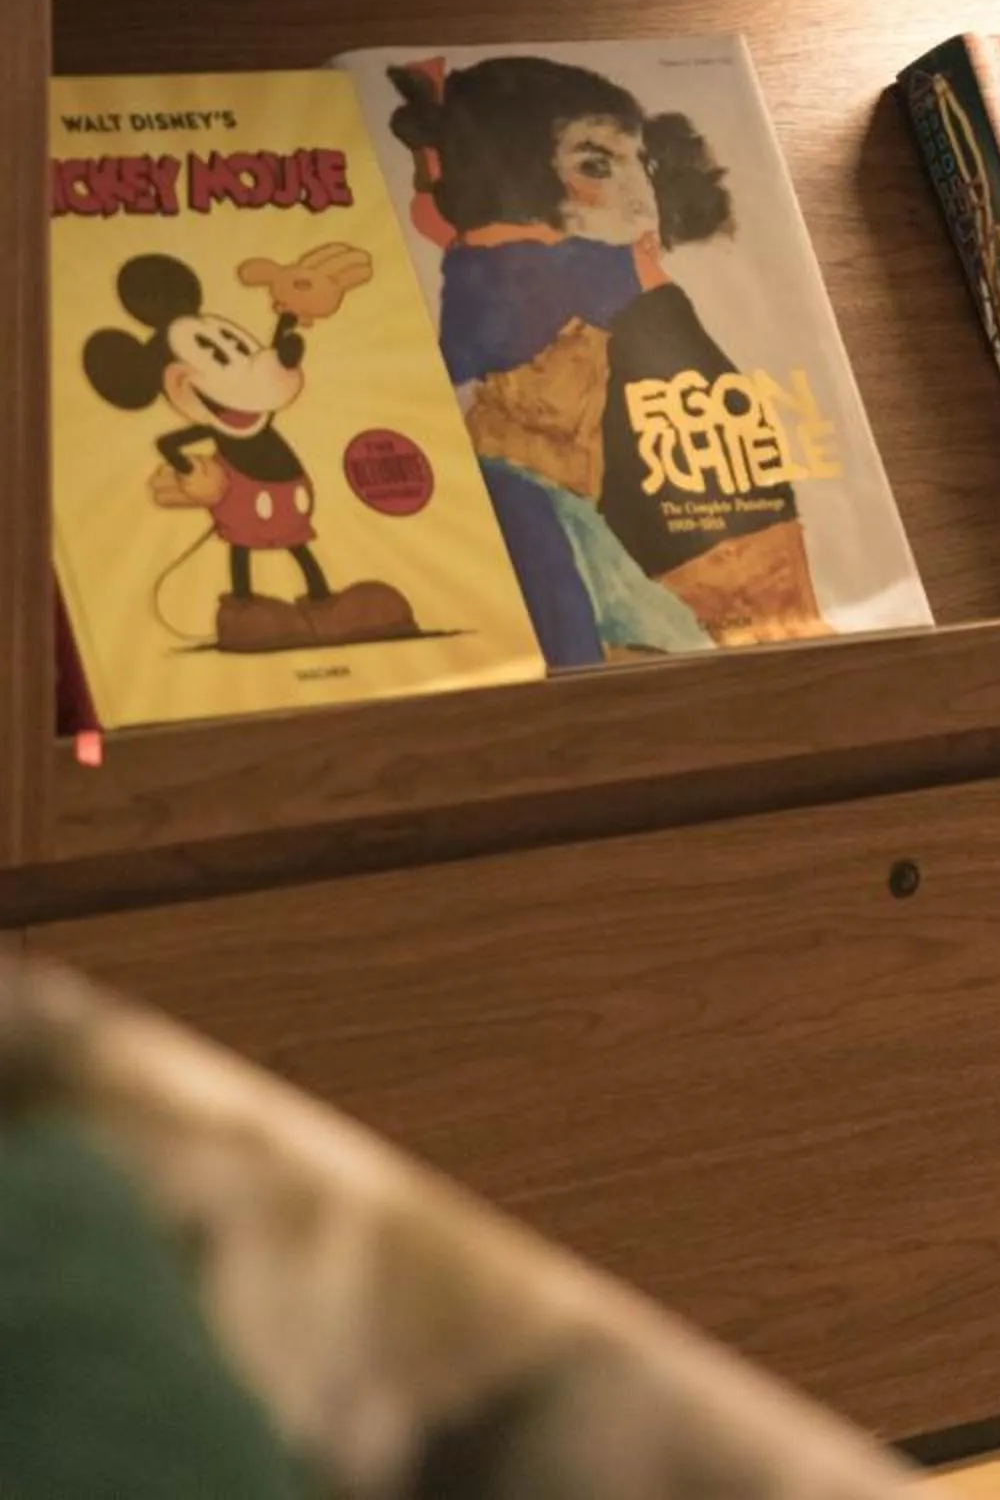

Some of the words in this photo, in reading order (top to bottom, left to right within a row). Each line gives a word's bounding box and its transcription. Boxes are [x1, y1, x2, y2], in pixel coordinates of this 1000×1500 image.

[61, 113, 124, 133] WALT
[130, 109, 238, 132] DISNEY'S
[51, 152, 182, 220] ICKEY
[186, 147, 354, 214] MOUSE
[624, 368, 822, 434] EGON
[638, 418, 842, 496] SCHIELE
